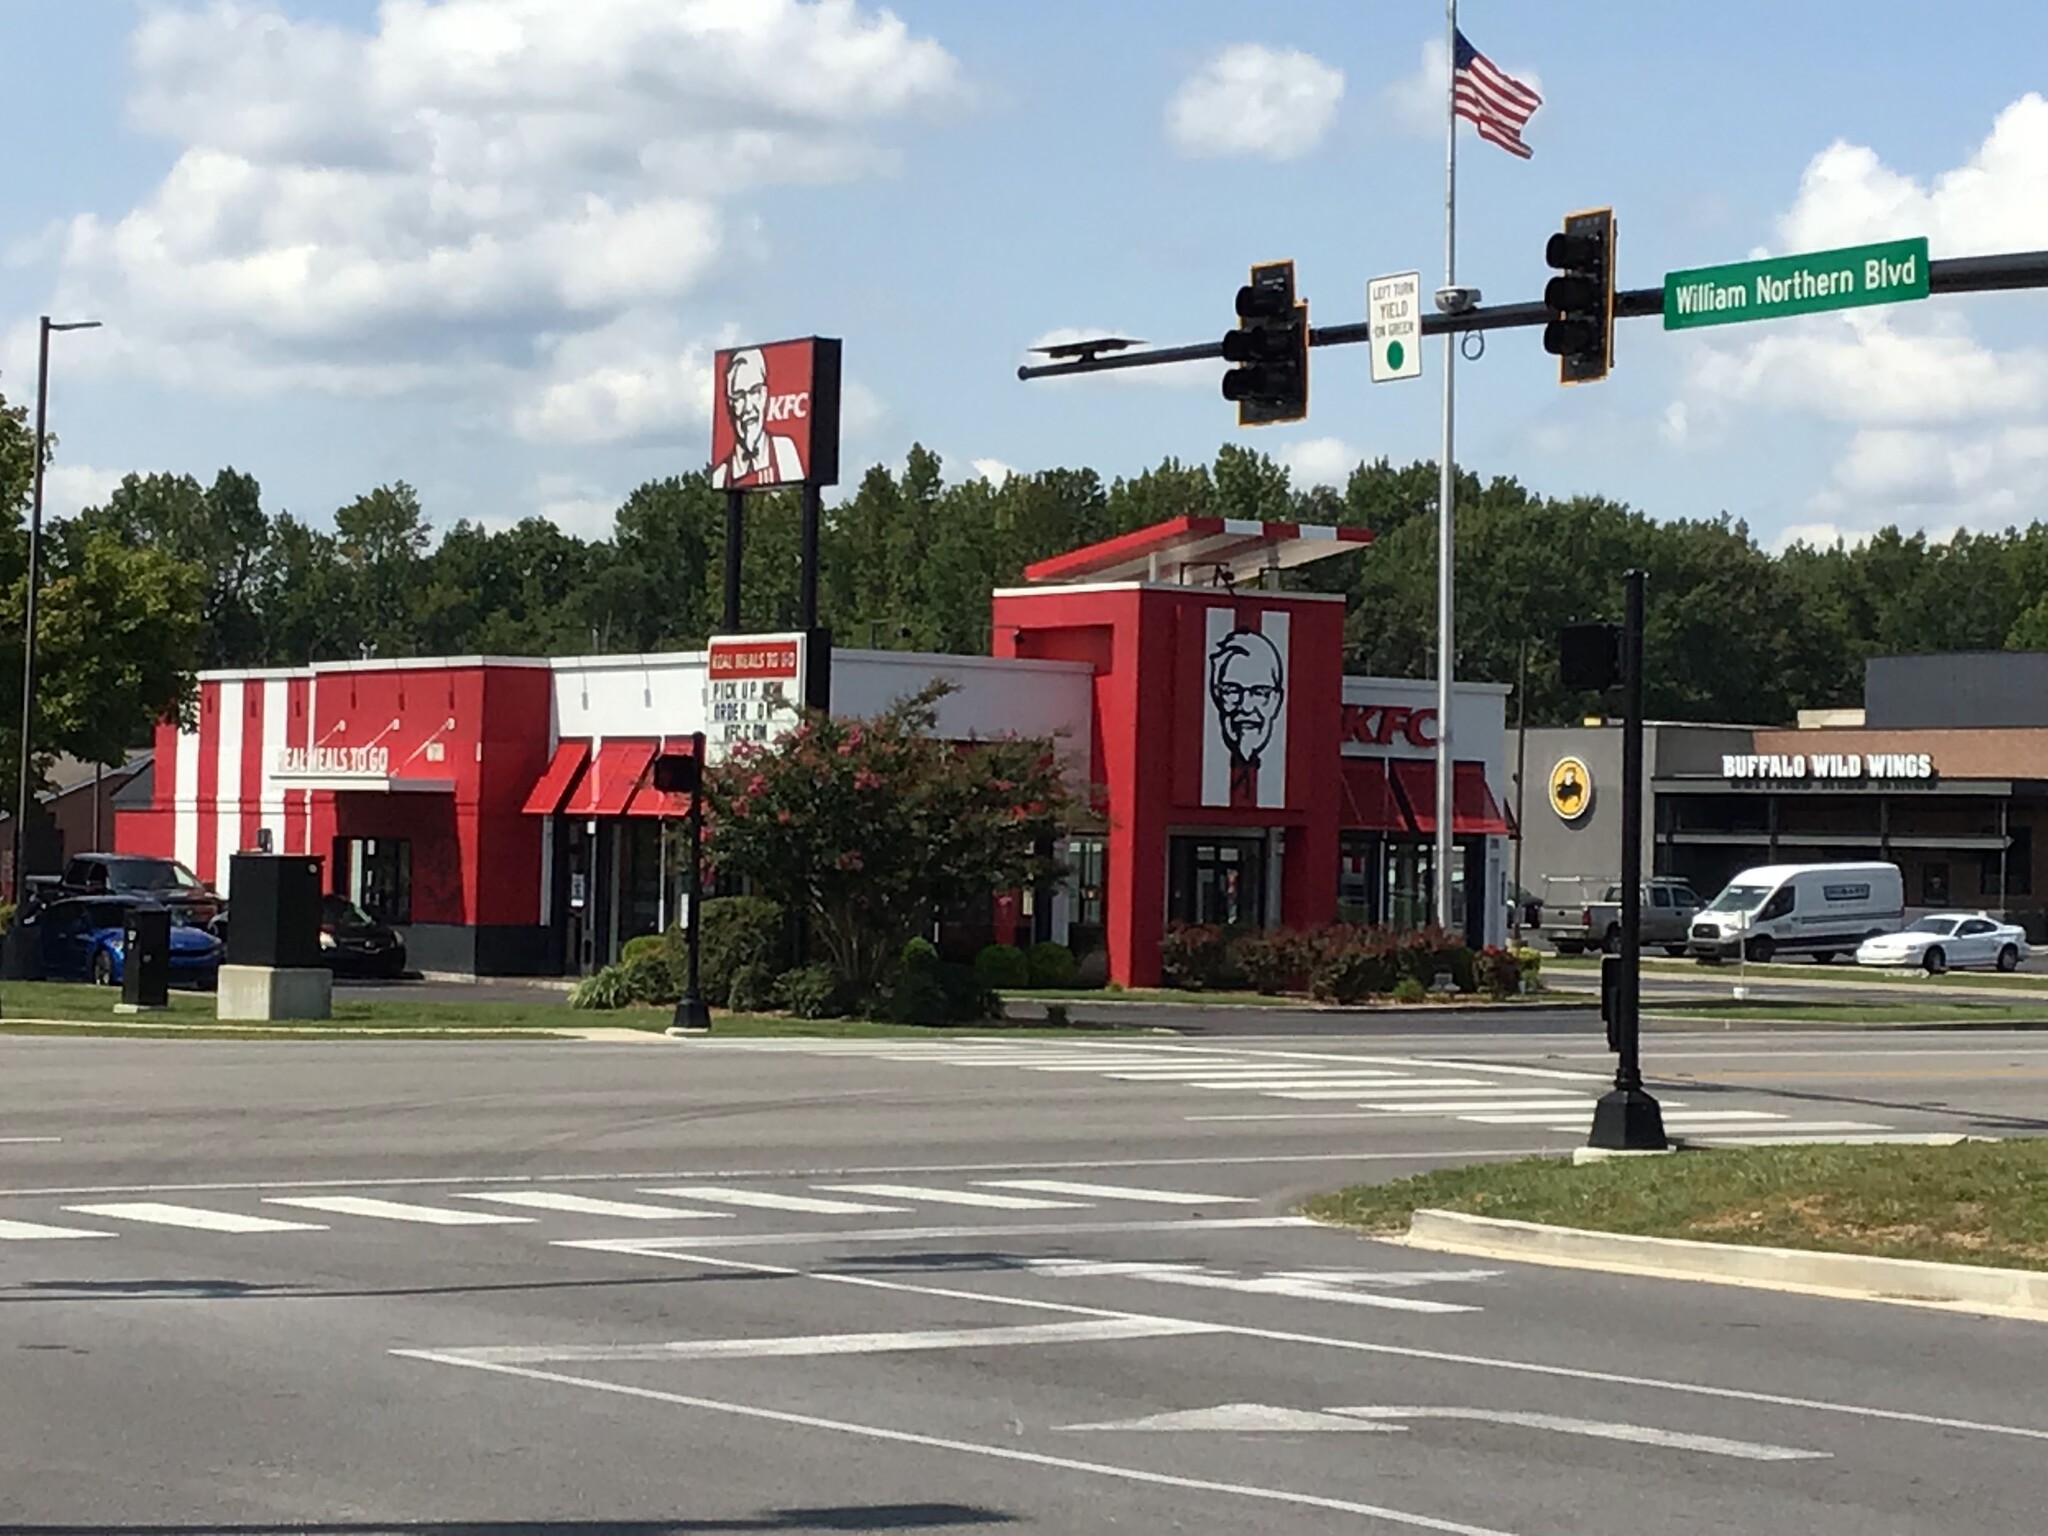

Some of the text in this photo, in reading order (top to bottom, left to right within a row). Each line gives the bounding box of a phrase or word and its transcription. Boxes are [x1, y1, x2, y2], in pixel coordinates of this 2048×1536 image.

[1373, 281, 1415, 301] LEFT TURN
[1676, 254, 1916, 314] William Northern Blvd
[1380, 300, 1409, 320] YIELD
[1373, 320, 1414, 339] ON GREEN
[766, 391, 809, 422] KFC
[713, 682, 737, 700] PICK
[742, 681, 757, 700] UP
[714, 703, 748, 721] ORDER
[1341, 704, 1437, 748] KFC
[350, 747, 368, 772] TO
[369, 746, 389, 773] GO
[1722, 753, 1932, 778] BUFFALO WILD WINGS
